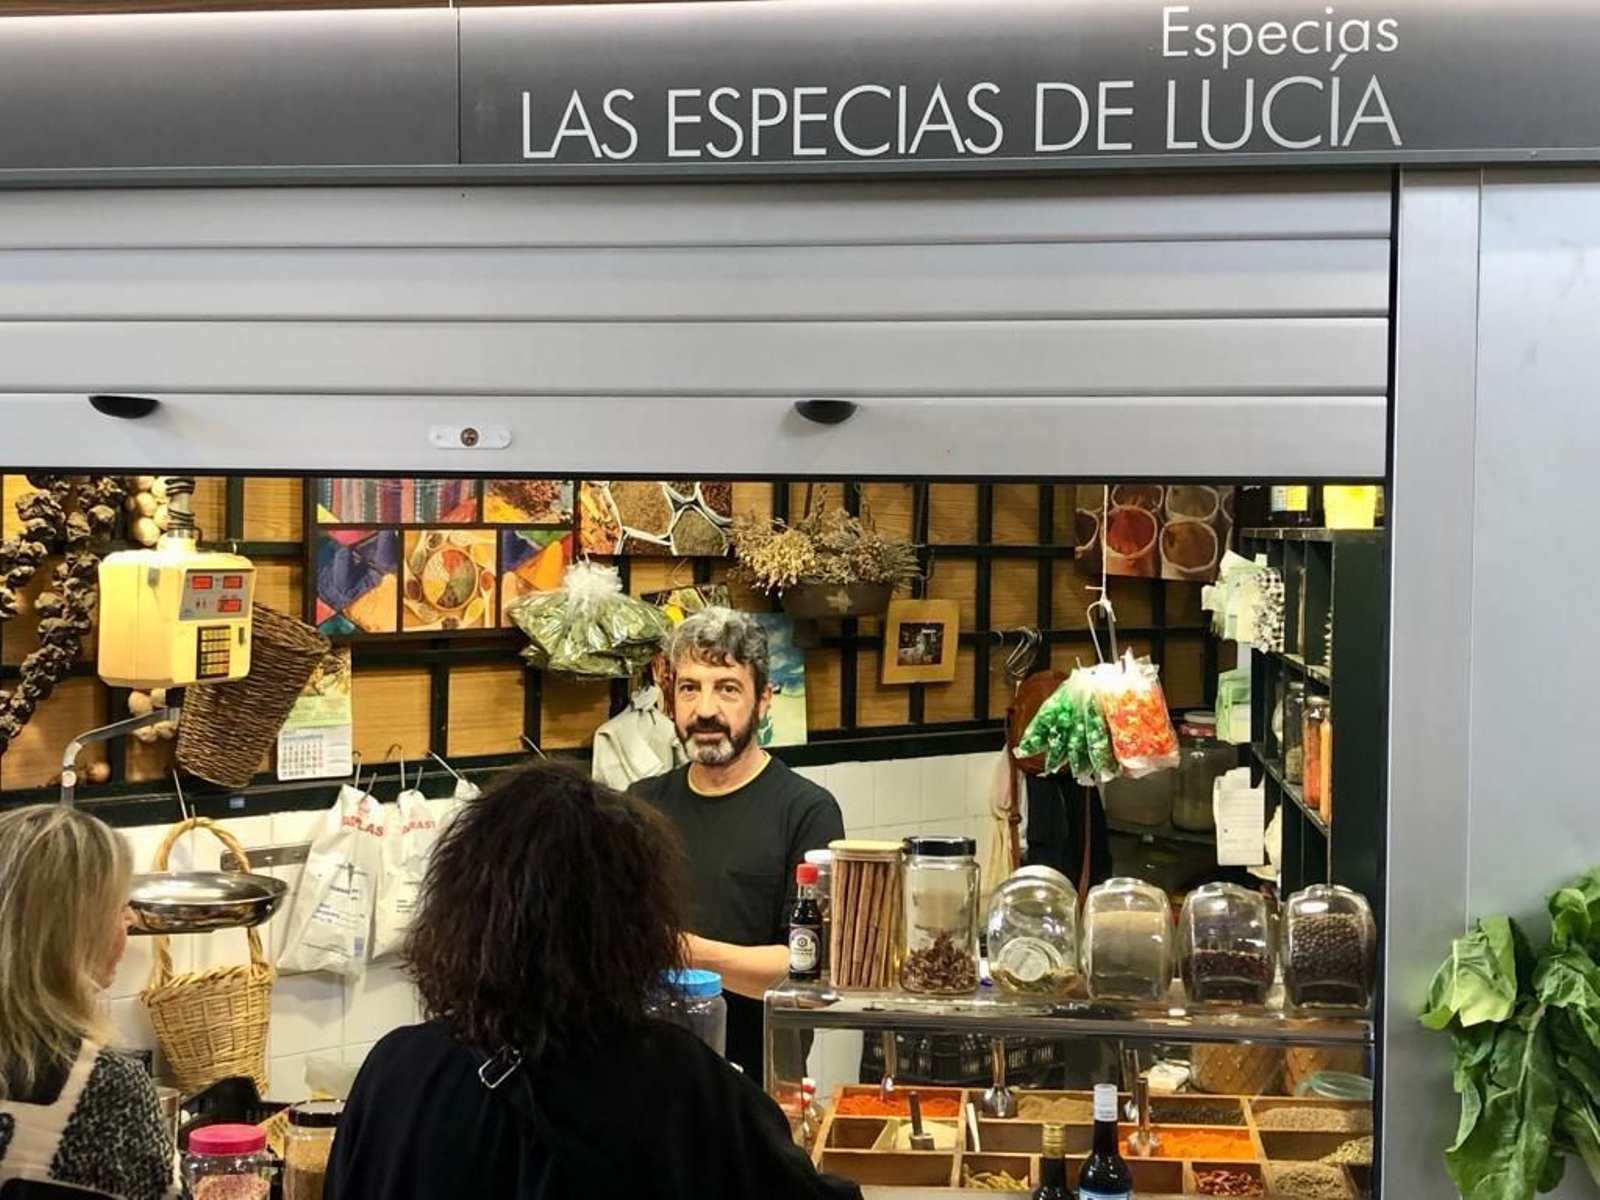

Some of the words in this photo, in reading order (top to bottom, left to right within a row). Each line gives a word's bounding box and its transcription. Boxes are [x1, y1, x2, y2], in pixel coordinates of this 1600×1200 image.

[1161, 5, 1399, 70] Especias
[521, 88, 638, 161] LAS
[667, 82, 1004, 159] ESPECIAS
[1034, 80, 1134, 153] DE
[1165, 53, 1403, 151] LUCÍA
